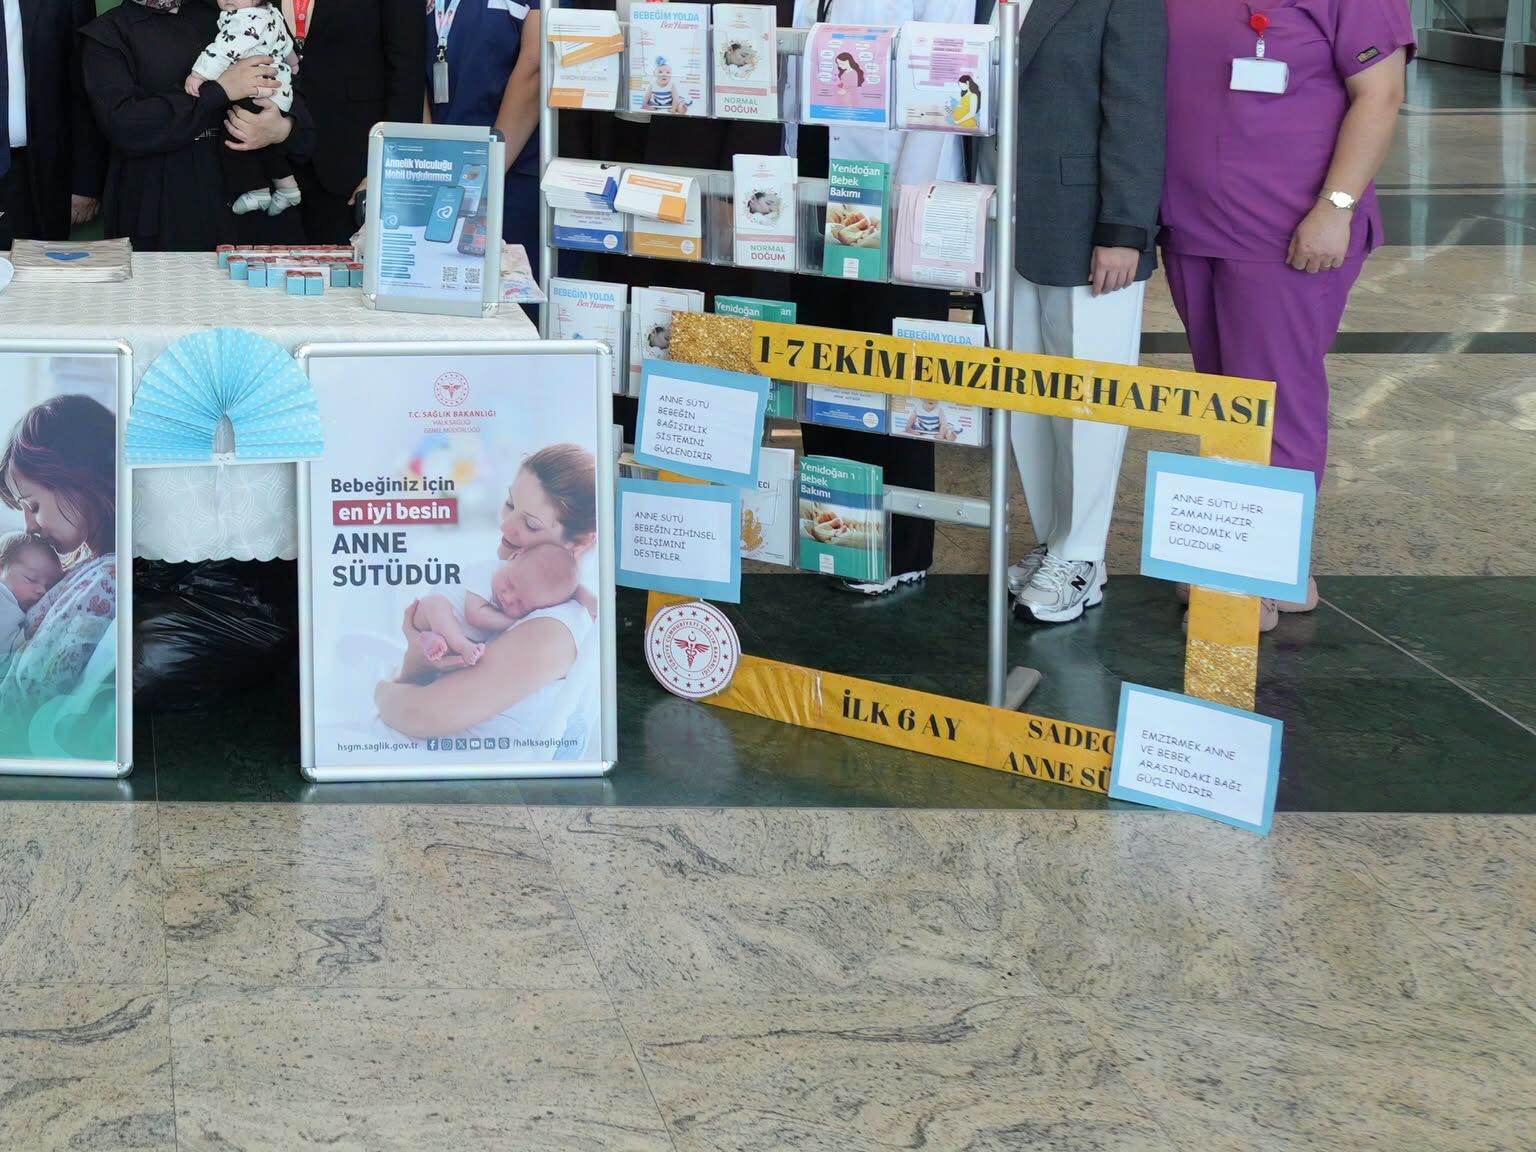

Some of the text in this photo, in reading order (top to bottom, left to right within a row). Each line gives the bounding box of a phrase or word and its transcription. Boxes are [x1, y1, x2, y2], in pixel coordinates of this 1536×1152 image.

[633, 9, 699, 21] BEBEĞİM YOLDA
[724, 105, 758, 114] DOĞUM
[386, 158, 452, 171] Annelik Yolculuğu
[831, 163, 881, 177] Yenidoğan
[385, 170, 405, 179] Mobil
[831, 175, 859, 186] Bebek
[830, 187, 861, 198] Bakımı
[750, 244, 785, 252] NORMAL
[751, 251, 786, 261] DOĞUM
[553, 287, 615, 301] BEBEĞİM YOLDA
[716, 302, 760, 317] Yenidoğan
[942, 334, 972, 345] YOLDA
[759, 335, 1271, 428] 1-7 EKİM EMZİRME HAFTASI
[659, 395, 683, 406] ANNE
[423, 410, 451, 418] SAĞLIK
[800, 461, 848, 479] Yenidoğan
[331, 476, 455, 496] Bebeğiniz için
[801, 473, 828, 486] Bebek
[800, 484, 831, 498] Bakımı
[1172, 493, 1204, 506] ANNE
[1241, 503, 1263, 514] HER
[339, 502, 450, 524] en iyi besin
[635, 512, 658, 521] ANNE
[1171, 507, 1213, 521] ZAMAN
[332, 532, 407, 554] ANNE
[1235, 532, 1248, 542] VE
[332, 558, 461, 586] SÜTÜDÜR
[842, 689, 963, 741] İLK 6 AY
[1028, 719, 1114, 754] SADEC
[1140, 744, 1192, 763] VE BEBEK
[1203, 747, 1236, 761] ANNE
[1002, 751, 1074, 783] ANNE
[1214, 777, 1242, 792] BAĞI
